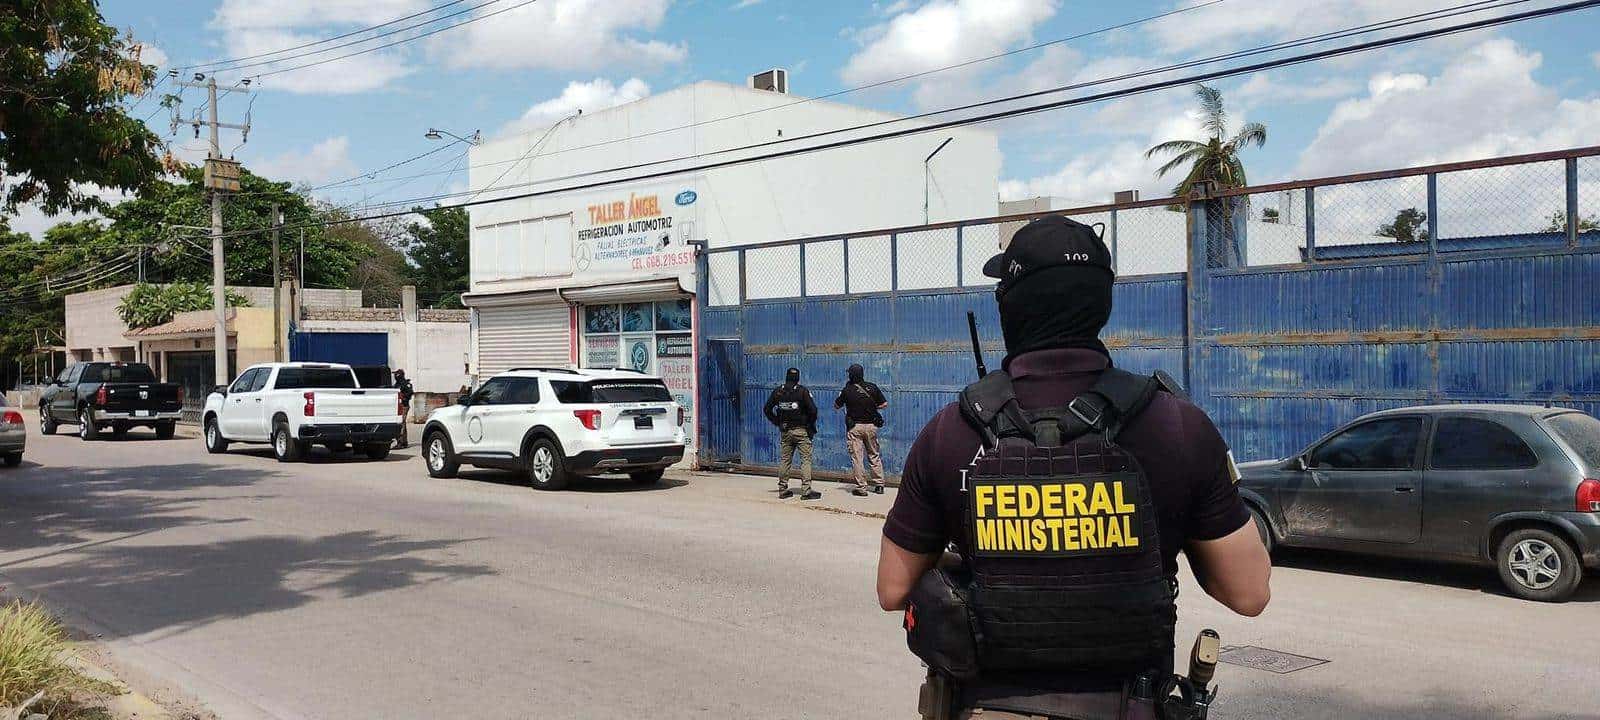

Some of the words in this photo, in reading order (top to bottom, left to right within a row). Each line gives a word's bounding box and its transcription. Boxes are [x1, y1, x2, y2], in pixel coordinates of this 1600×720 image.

[588, 200, 625, 225] TALLER
[627, 216, 672, 233] AUTOMOTRIZ
[663, 365, 690, 375] TALLER
[975, 480, 1136, 517] FEDERAL
[976, 516, 1139, 552] MINISTERIAL
